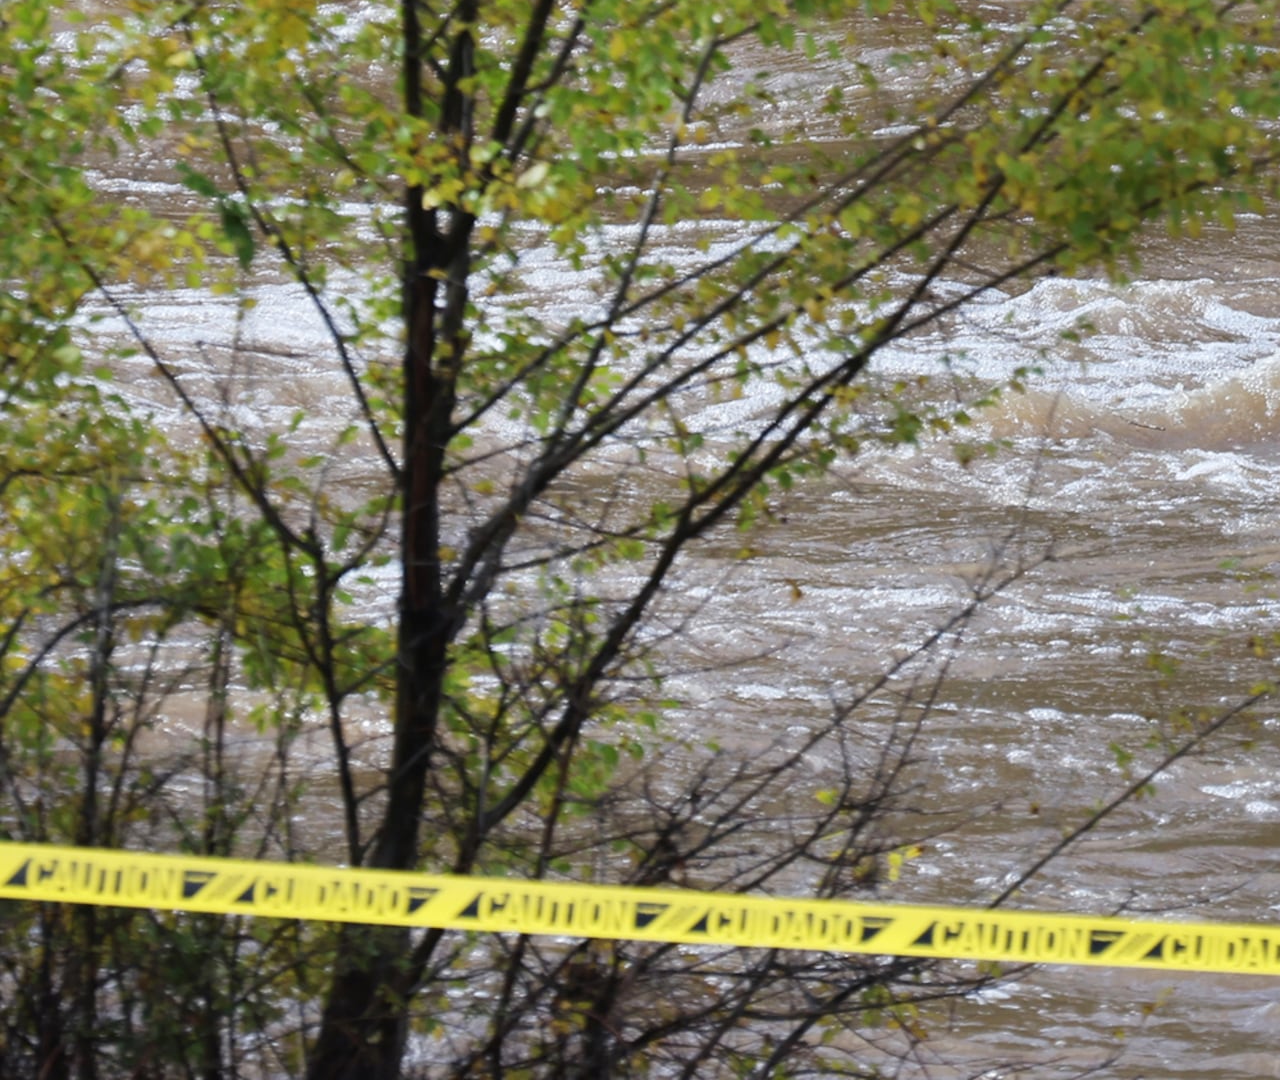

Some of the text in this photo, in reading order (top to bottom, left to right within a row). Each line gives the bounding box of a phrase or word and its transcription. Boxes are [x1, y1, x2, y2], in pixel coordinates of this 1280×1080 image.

[28, 859, 183, 899] CAUTION
[256, 879, 408, 915] CUIDADO
[479, 892, 636, 931] CAUTION
[707, 907, 862, 944] CUIDADO
[932, 920, 1090, 957] CAUTION
